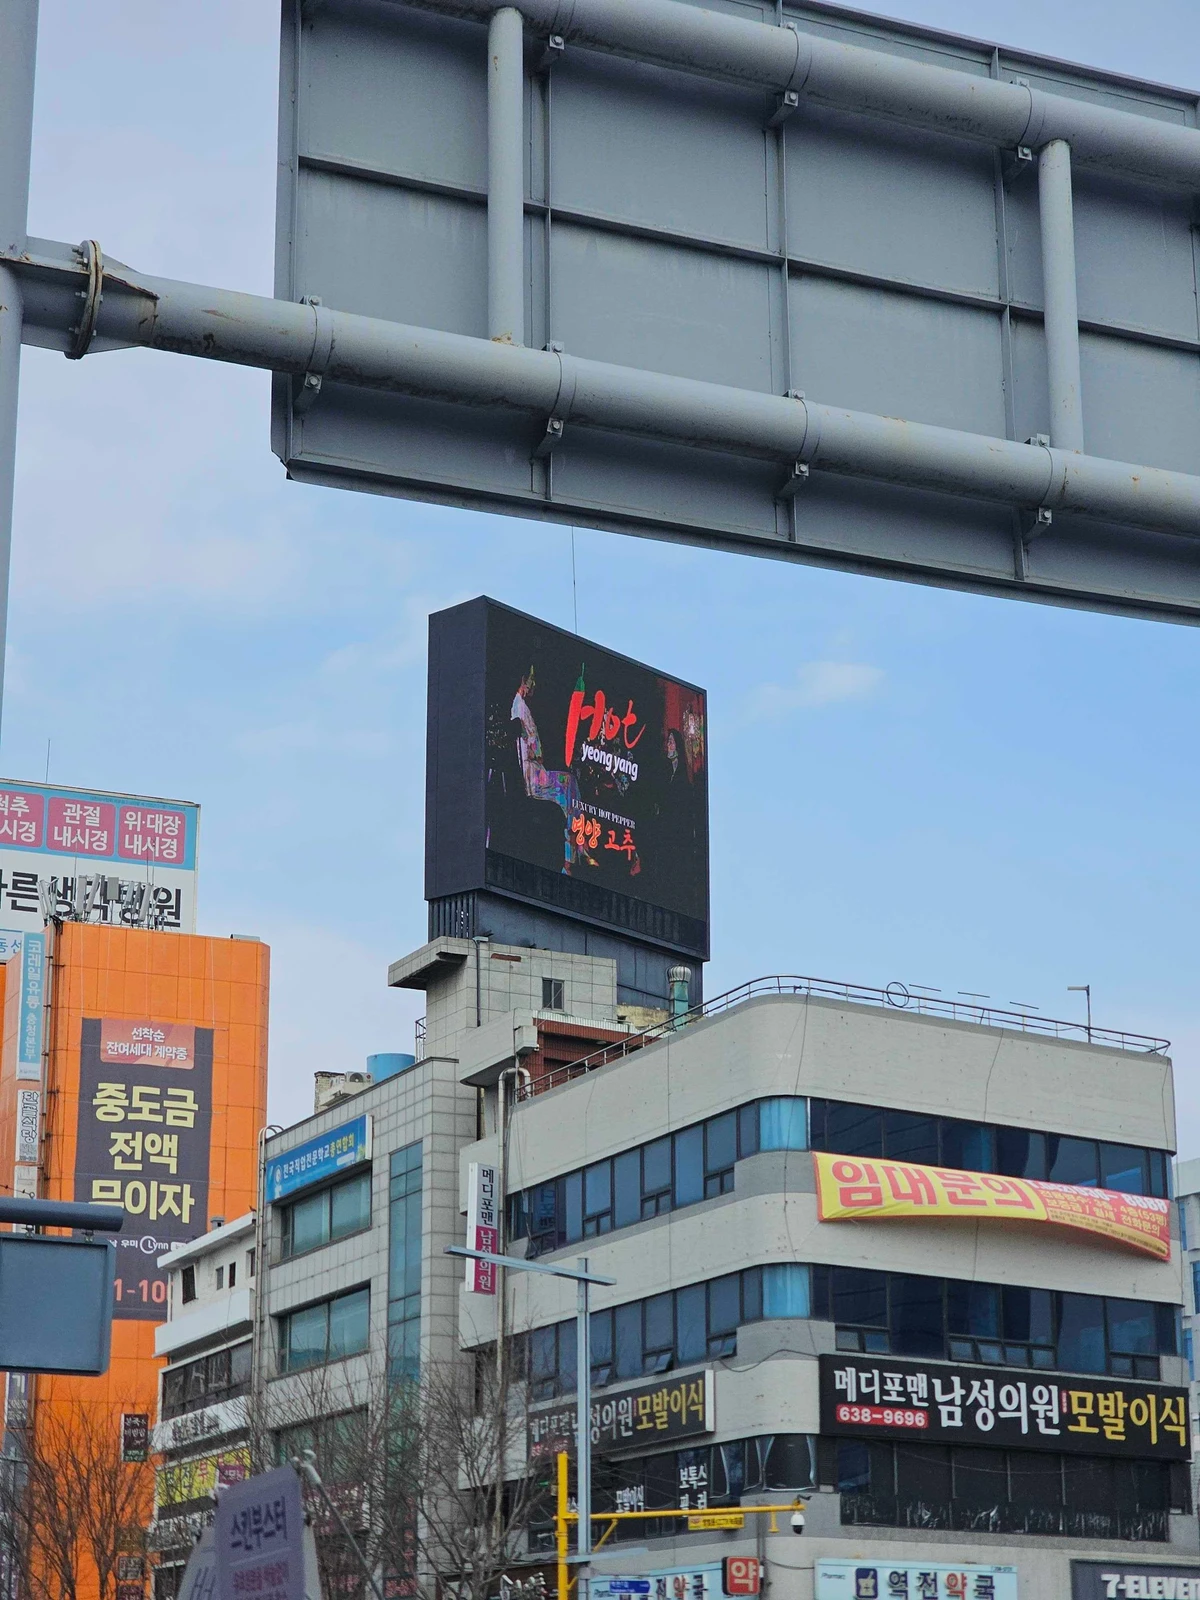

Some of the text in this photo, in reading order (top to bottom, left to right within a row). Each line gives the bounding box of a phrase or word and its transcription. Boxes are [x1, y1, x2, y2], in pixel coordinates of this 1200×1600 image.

[565, 690, 646, 767] Hot
[581, 743, 638, 781] yeong yang
[62, 803, 101, 827] 관절
[124, 811, 181, 836] 위·대장
[572, 799, 636, 830] LUXURY HOT PEPPER
[54, 826, 108, 851] 내시경
[124, 834, 177, 859] 내시경
[571, 814, 636, 861] 영양 고추
[106, 1041, 188, 1060] 잔여세대 계약중
[131, 1027, 165, 1043] 선착순
[92, 1082, 199, 1129] 중도금
[108, 1131, 179, 1175] 전액
[481, 1168, 495, 1227] 메디포맨
[831, 1160, 1036, 1210] 임대문의
[120, 1239, 139, 1249] 우미
[636, 1379, 704, 1432] 모발이식
[833, 1367, 930, 1407] 메디포맨
[931, 1376, 1061, 1436] 남성의원
[1067, 1390, 1186, 1447] 모발이식
[839, 1407, 926, 1427] 638-9696
[679, 1463, 708, 1489] 보톡스
[731, 1561, 757, 1592] 약
